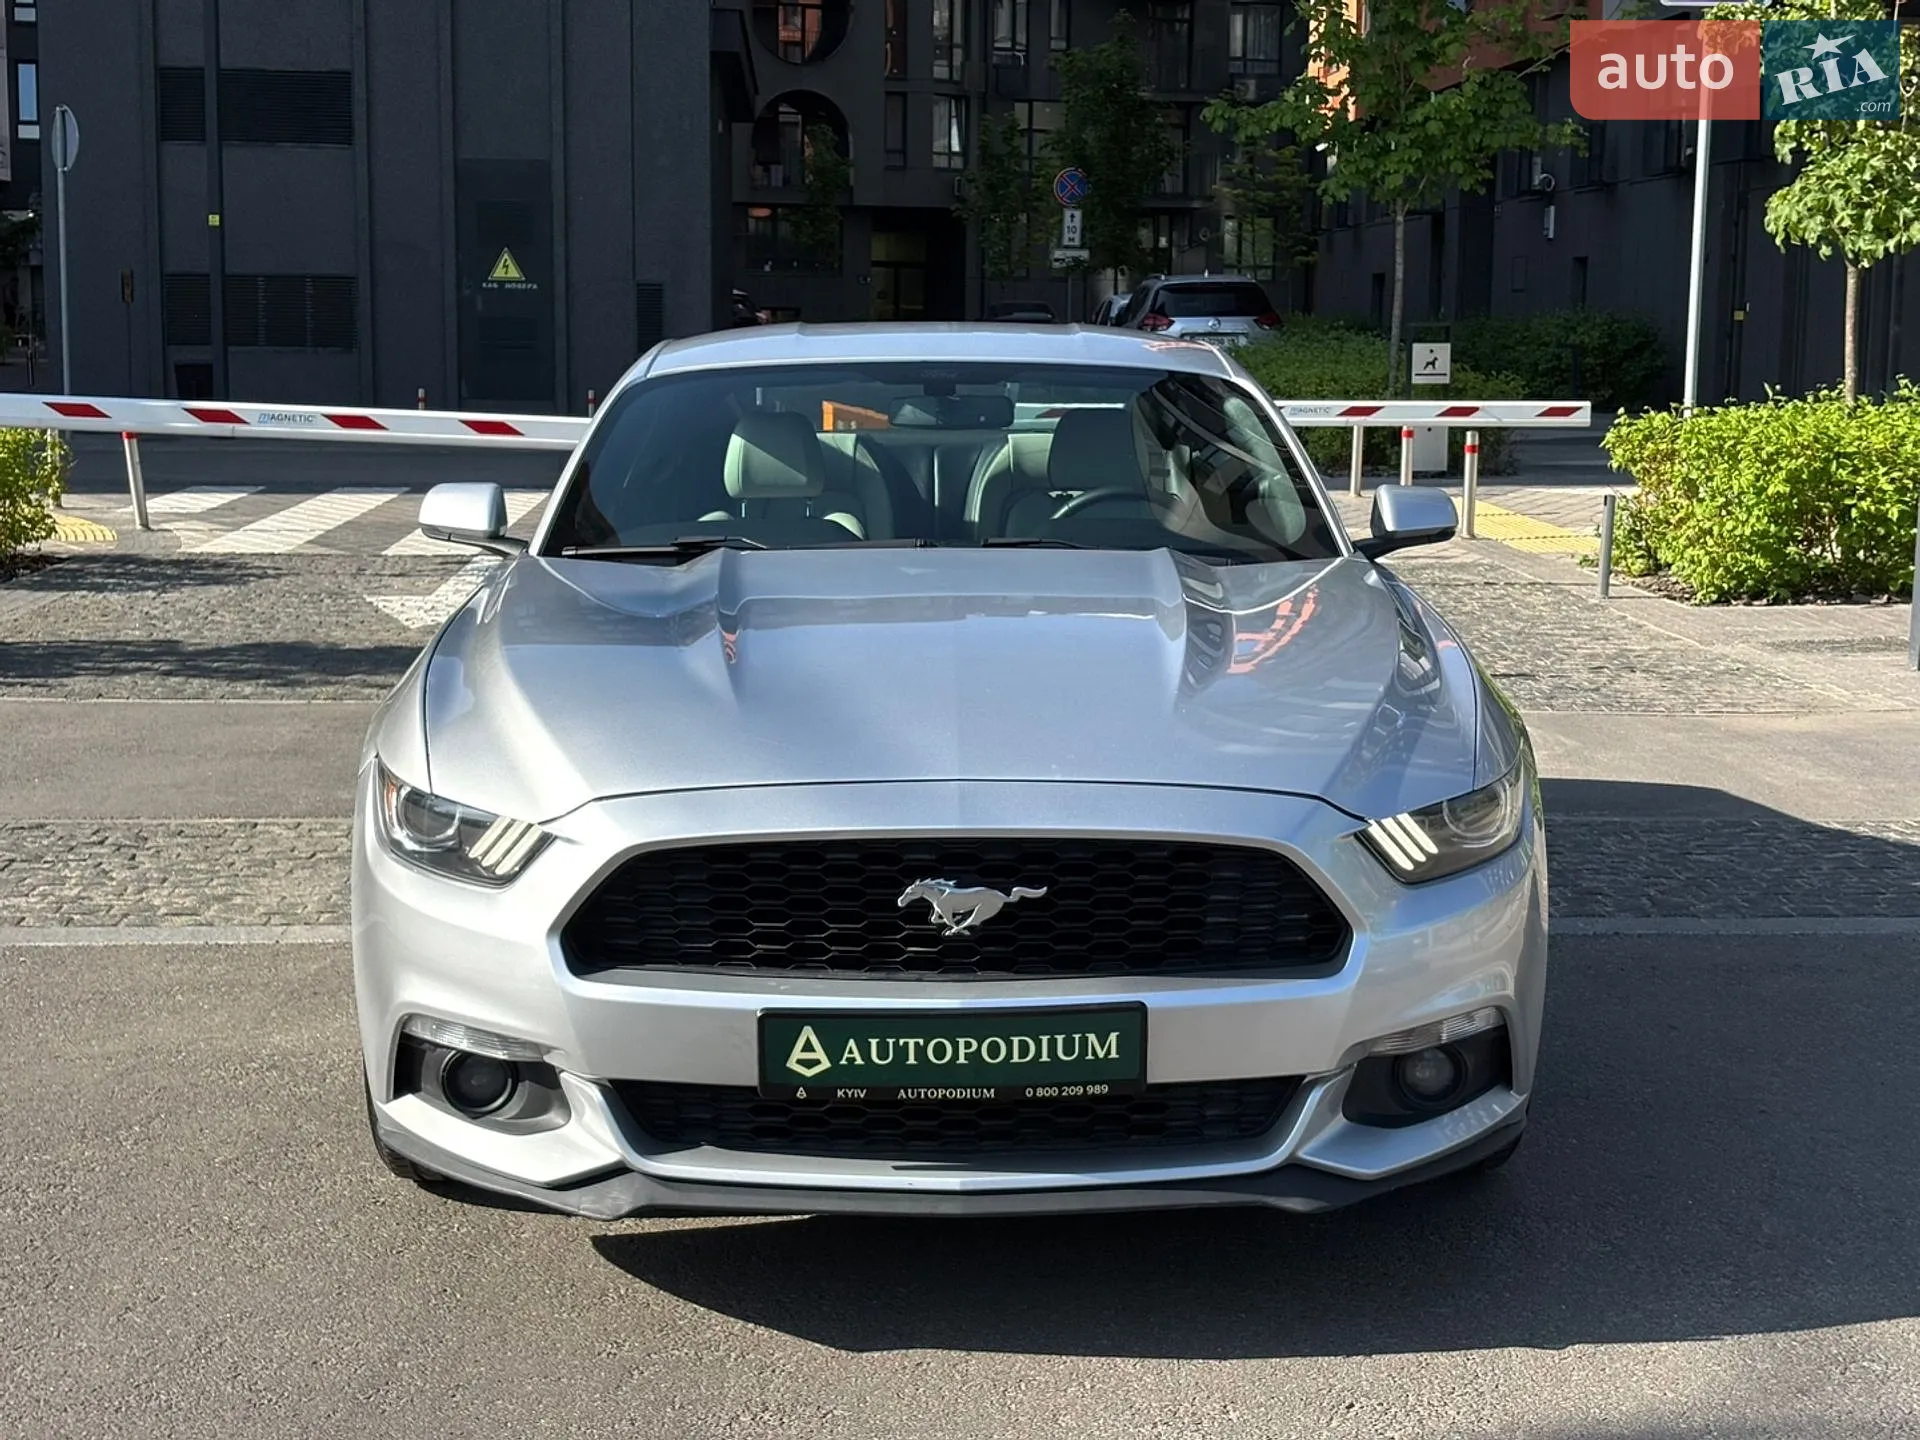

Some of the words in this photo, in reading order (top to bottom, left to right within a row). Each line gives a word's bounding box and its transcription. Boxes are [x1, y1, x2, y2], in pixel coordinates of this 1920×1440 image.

[1066, 225, 1078, 235] 10
[839, 1031, 1121, 1066] AUTOPODIUM
[837, 1088, 868, 1099] KYIV
[897, 1087, 996, 1100] AUTOPODIUM
[1025, 1087, 1034, 1098] 0
[1036, 1086, 1059, 1097] 800
[1061, 1085, 1084, 1097] 209
[1086, 1083, 1109, 1095] 989
